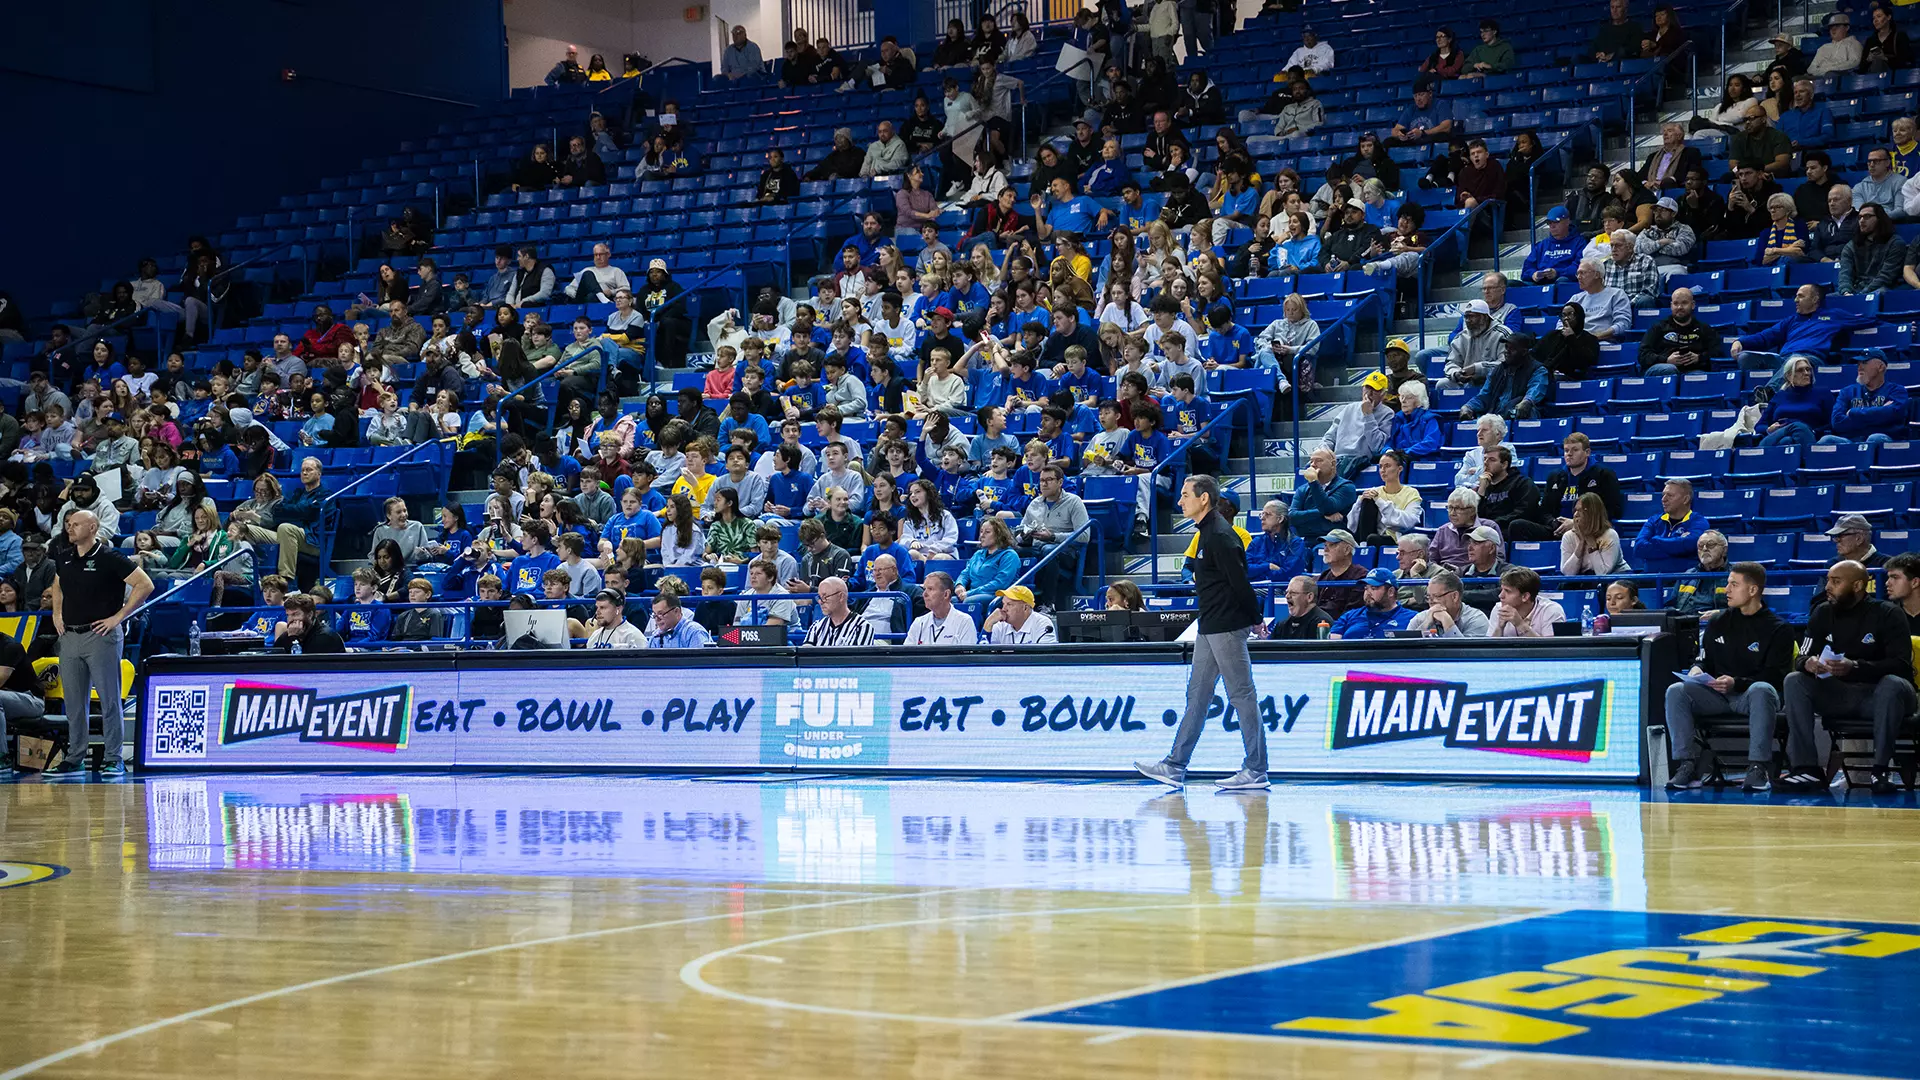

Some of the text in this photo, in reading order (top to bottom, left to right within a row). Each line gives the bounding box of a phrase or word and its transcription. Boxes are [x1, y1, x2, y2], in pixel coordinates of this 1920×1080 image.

[1272, 478, 1286, 489] FOR
[527, 614, 538, 630] hp
[741, 630, 760, 642] POSS.
[793, 677, 858, 689] SO MUCH
[234, 693, 401, 738] MAIN EVENT
[415, 697, 755, 733] EAT BOWL PLAY
[775, 692, 874, 727] FUN
[900, 696, 984, 732] EAT
[1021, 695, 1146, 732] BOWL
[1346, 689, 1595, 743] MAIN EVENT
[803, 731, 845, 741] UNDER
[783, 742, 863, 759] ONE ROOF
